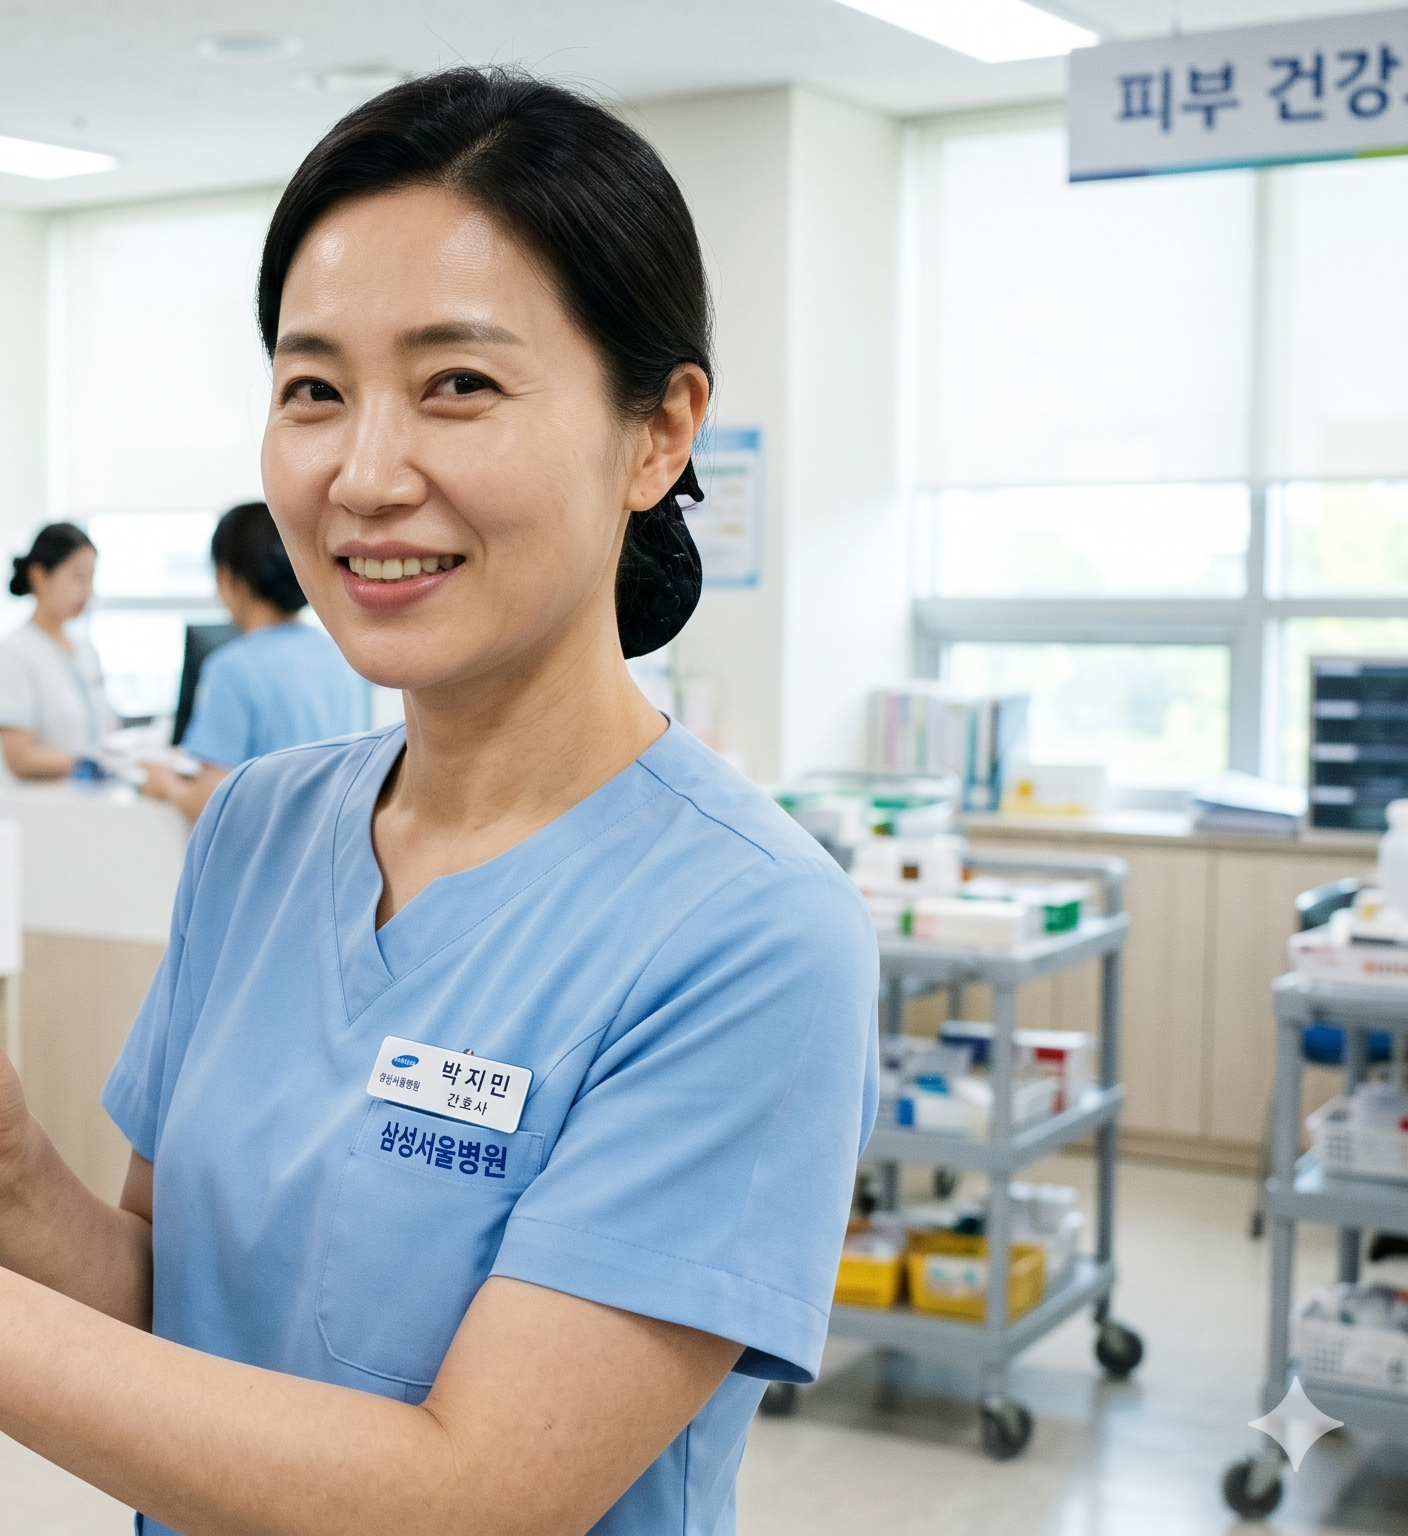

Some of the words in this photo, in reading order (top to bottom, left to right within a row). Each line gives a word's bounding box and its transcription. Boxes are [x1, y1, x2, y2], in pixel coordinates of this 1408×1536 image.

[1116, 63, 1240, 133] 피부
[1267, 42, 1408, 122] 건강
[447, 1093, 489, 1116] 간호사
[379, 1120, 508, 1179] 삼성서울병원
